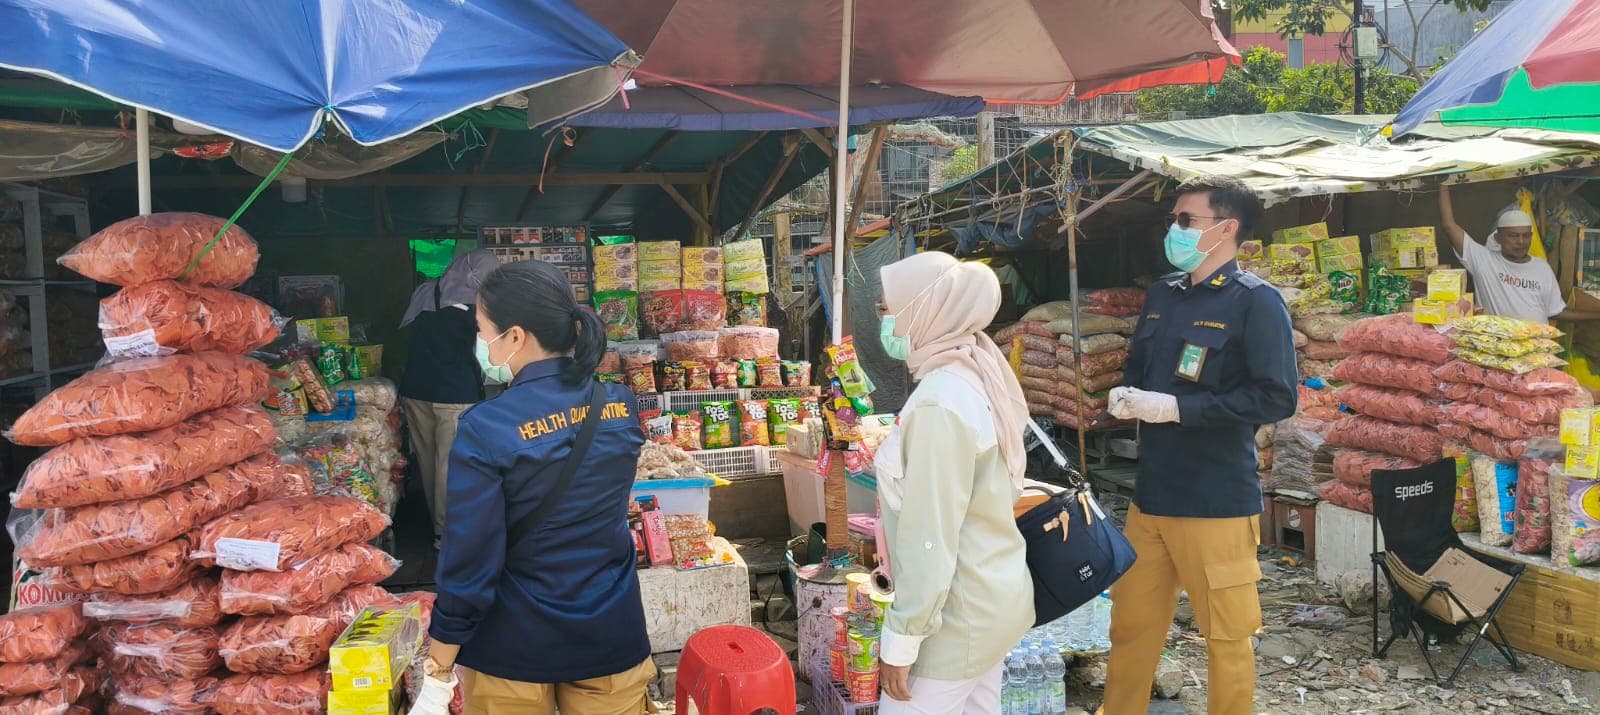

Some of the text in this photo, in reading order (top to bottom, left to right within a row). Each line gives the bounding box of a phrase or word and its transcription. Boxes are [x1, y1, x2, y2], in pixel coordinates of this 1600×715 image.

[1498, 272, 1541, 290] BANDUNG
[704, 404, 725, 415] TOS
[518, 402, 630, 440] HEALTH QUANTINE
[1395, 480, 1434, 501] speeds
